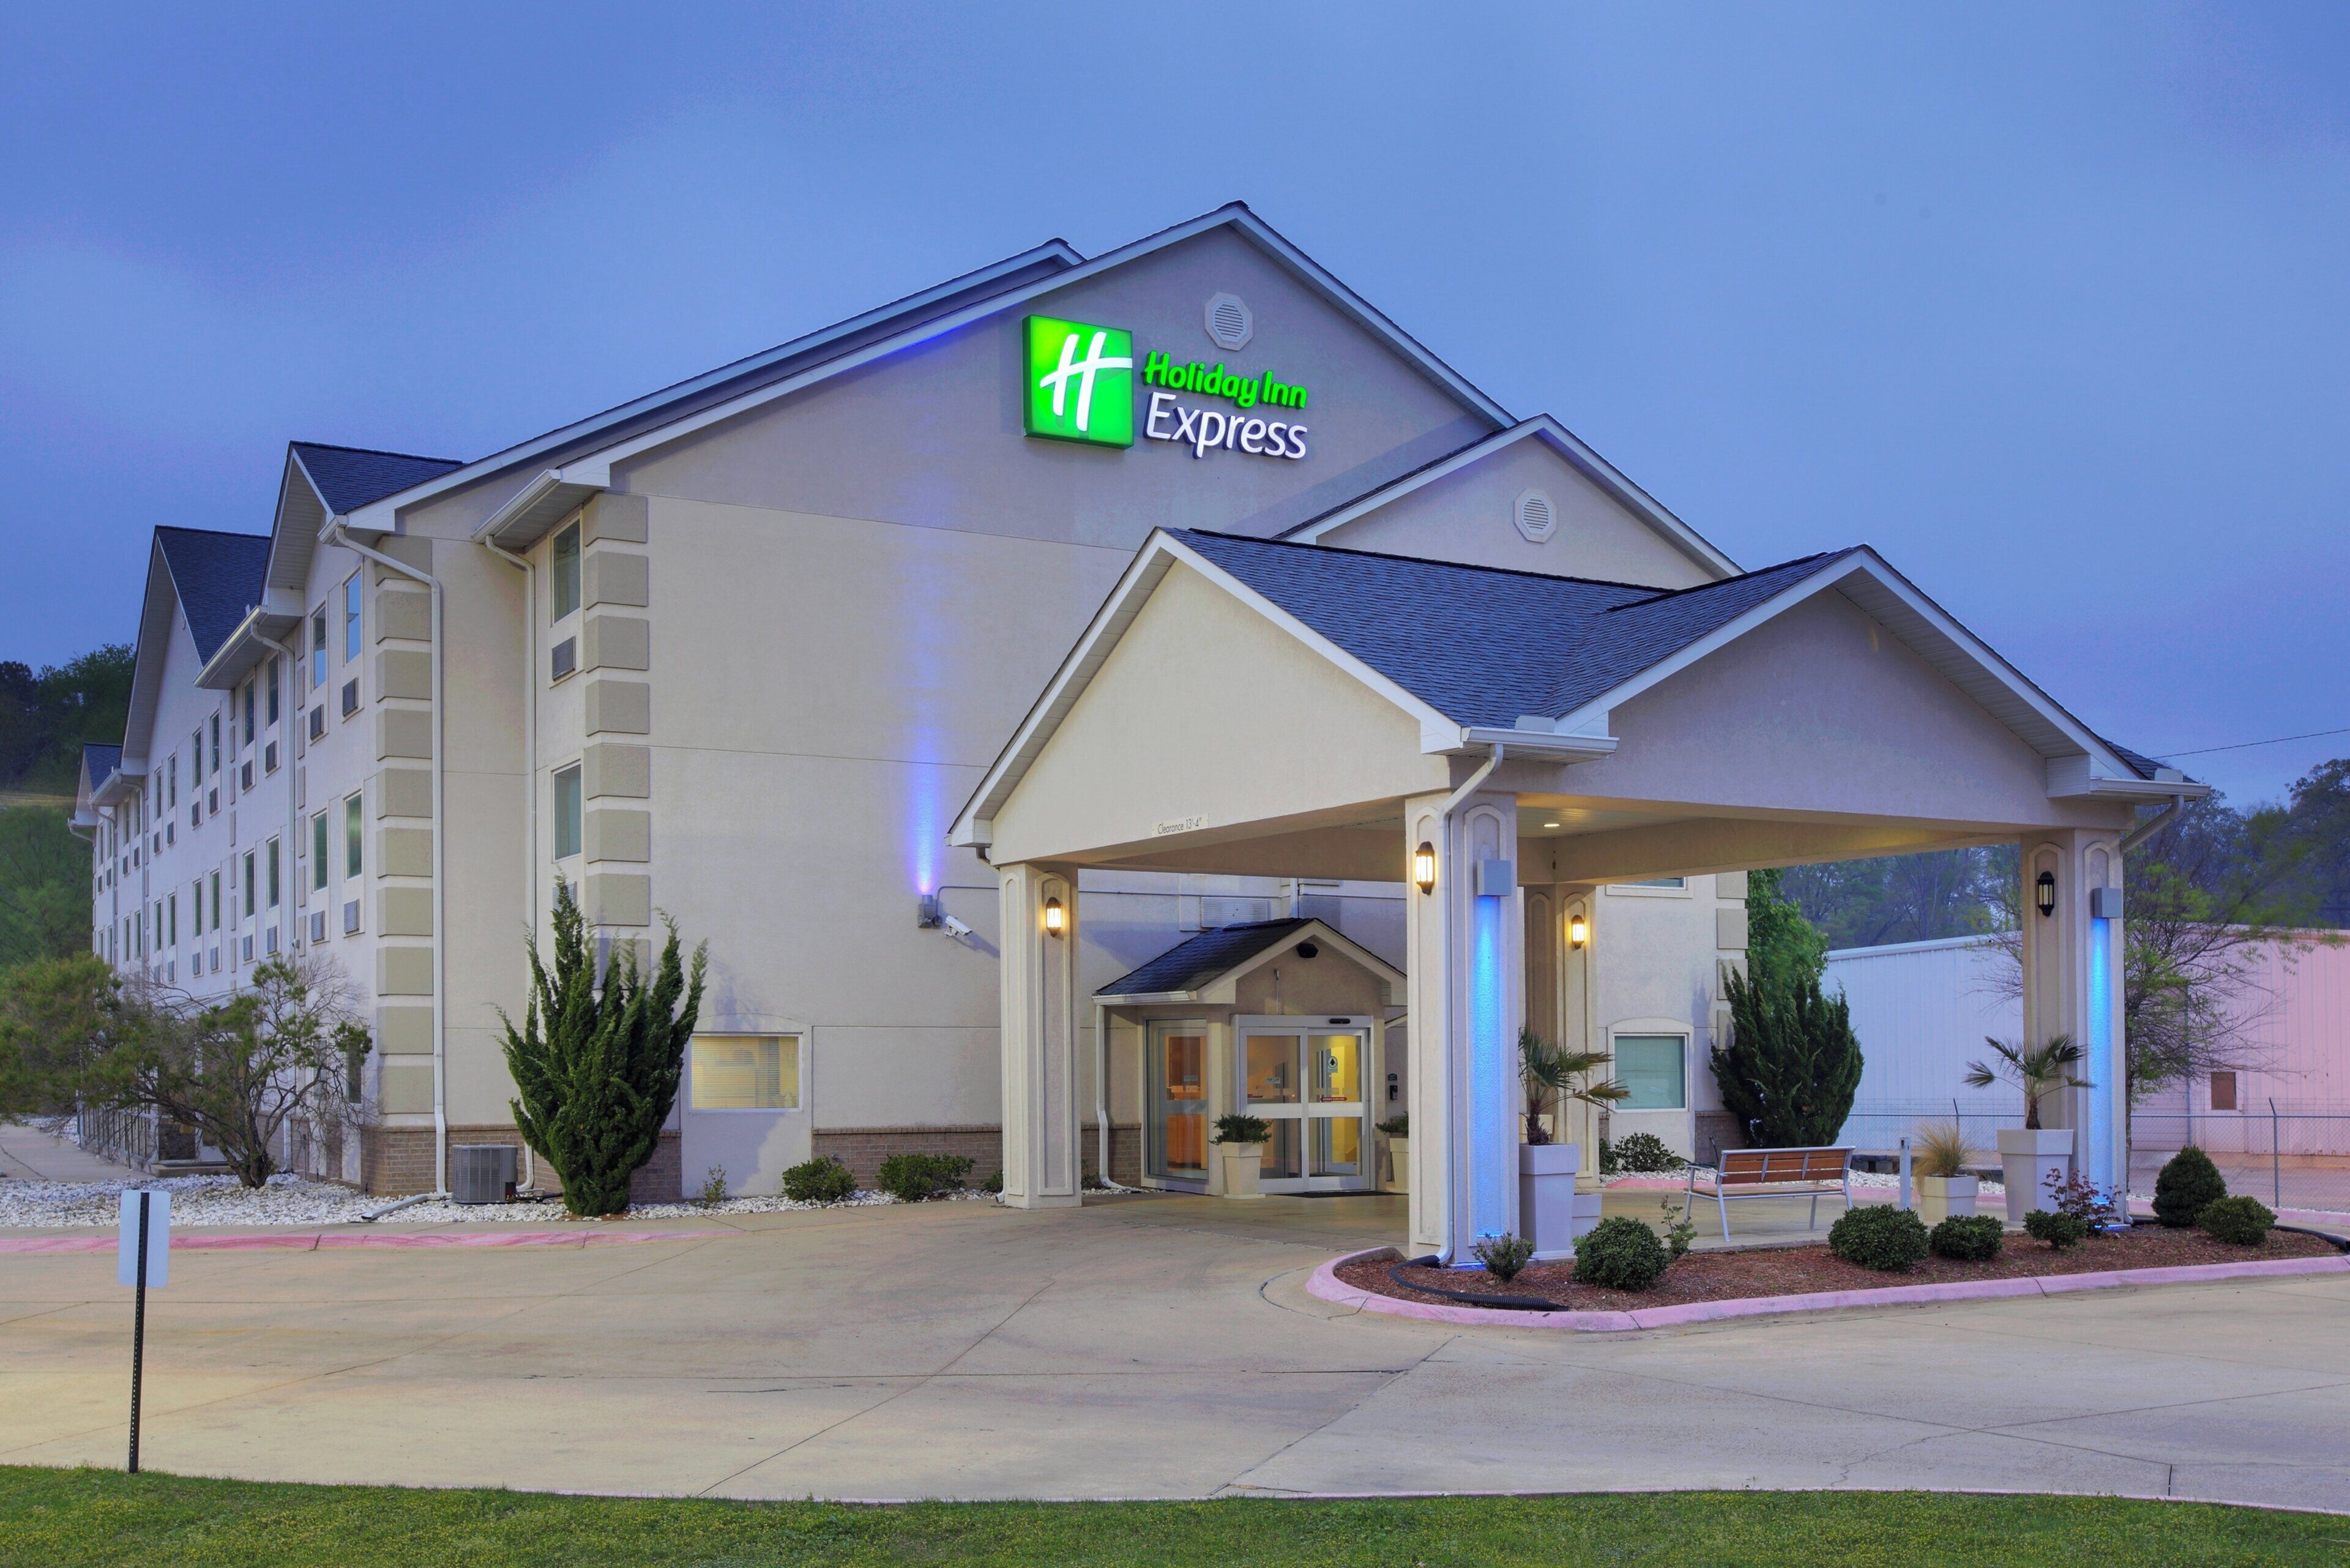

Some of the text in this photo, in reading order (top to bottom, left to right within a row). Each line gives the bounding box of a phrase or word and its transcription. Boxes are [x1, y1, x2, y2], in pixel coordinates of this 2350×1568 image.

[1142, 350, 1307, 409] Holiday Inn
[1145, 391, 1308, 459] Express
[1157, 822, 1184, 834] Clearance
